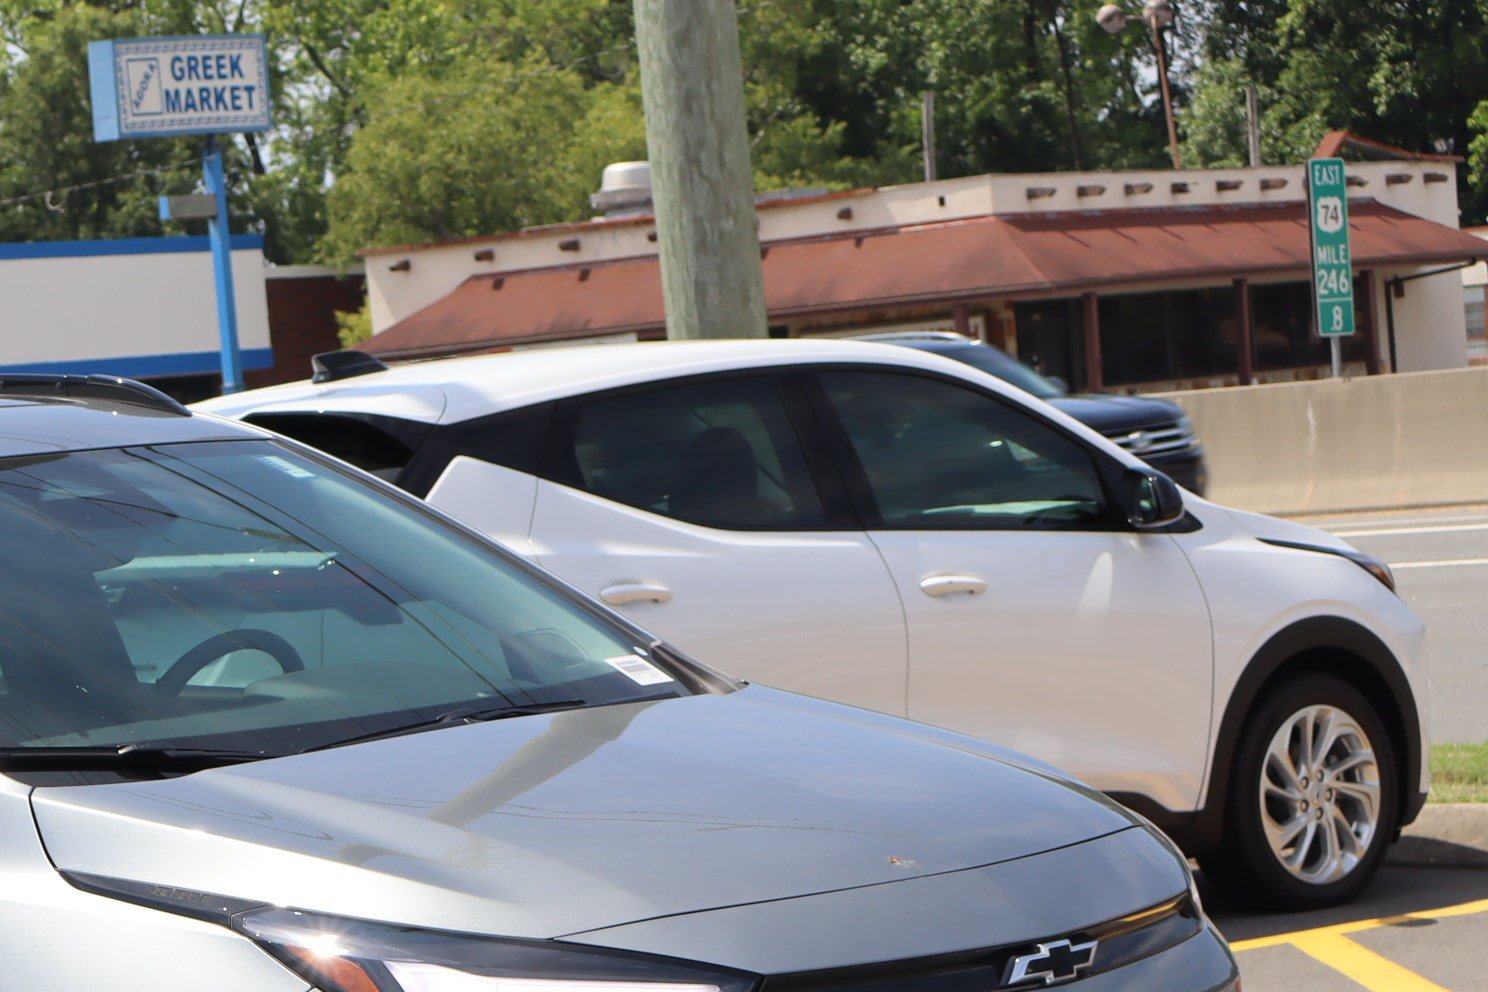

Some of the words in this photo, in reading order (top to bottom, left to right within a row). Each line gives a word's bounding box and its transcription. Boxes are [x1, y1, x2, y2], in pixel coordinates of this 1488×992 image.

[171, 54, 244, 82] GREEK
[165, 85, 256, 113] MARKET
[1314, 165, 1341, 186] EAST
[1320, 204, 1340, 225] 74
[1317, 244, 1347, 266] MILE
[1318, 269, 1350, 296] 246
